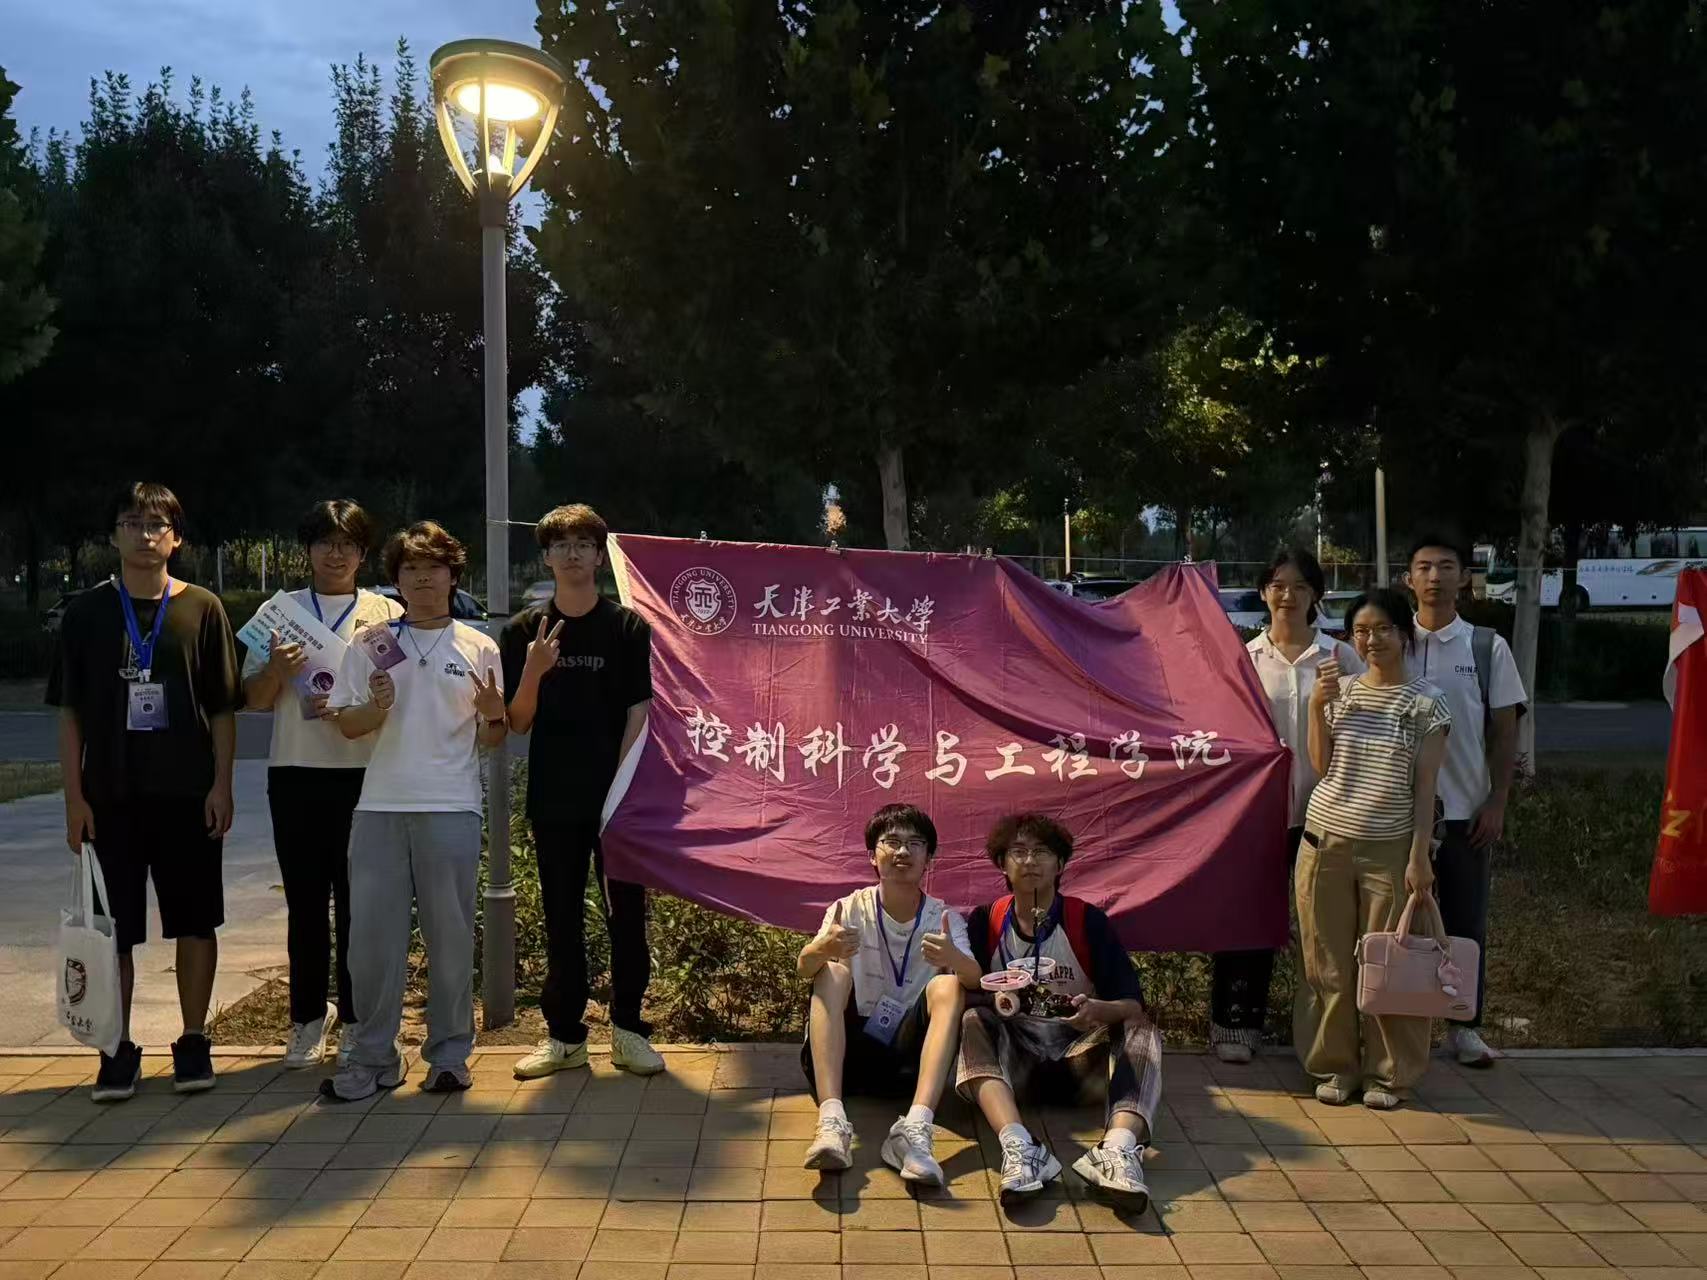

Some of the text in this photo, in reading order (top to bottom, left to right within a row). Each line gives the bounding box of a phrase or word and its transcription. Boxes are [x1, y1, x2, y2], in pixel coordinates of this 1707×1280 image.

[700, 570, 735, 610] UNIVERSITY
[752, 623, 928, 645] TIANGONG UNIVERSITY
[557, 655, 605, 671] assup
[686, 705, 1232, 789] 控制科学与工程学院
